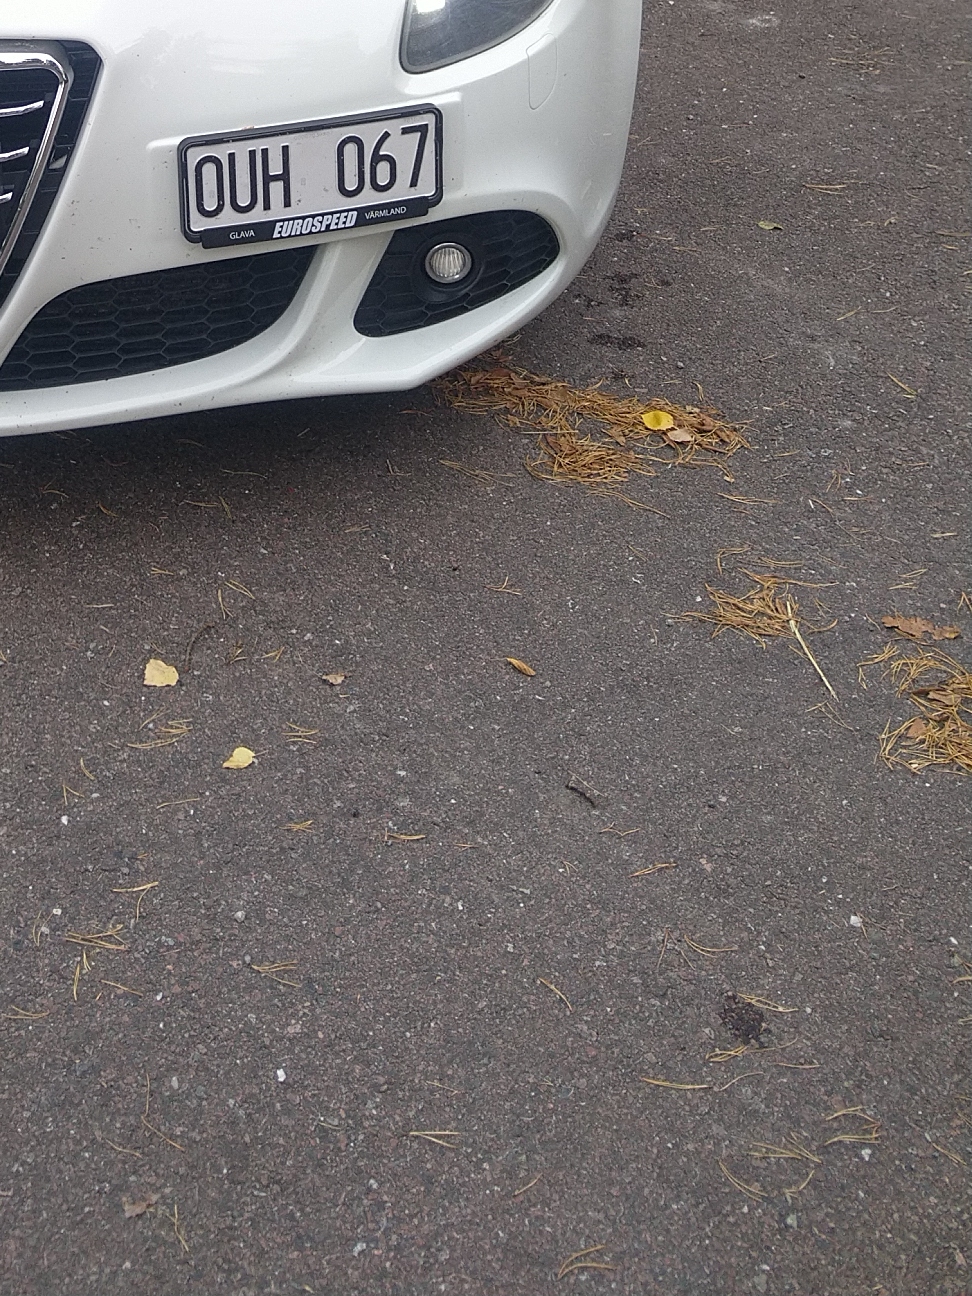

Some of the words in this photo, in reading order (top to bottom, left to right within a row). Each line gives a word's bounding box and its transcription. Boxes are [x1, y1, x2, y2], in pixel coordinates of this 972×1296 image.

[194, 143, 292, 218] OUH
[336, 123, 429, 198] 067
[229, 229, 255, 240] GLAVA
[272, 210, 358, 239] EUROSPEED
[364, 206, 407, 220] VÄRMLAND
